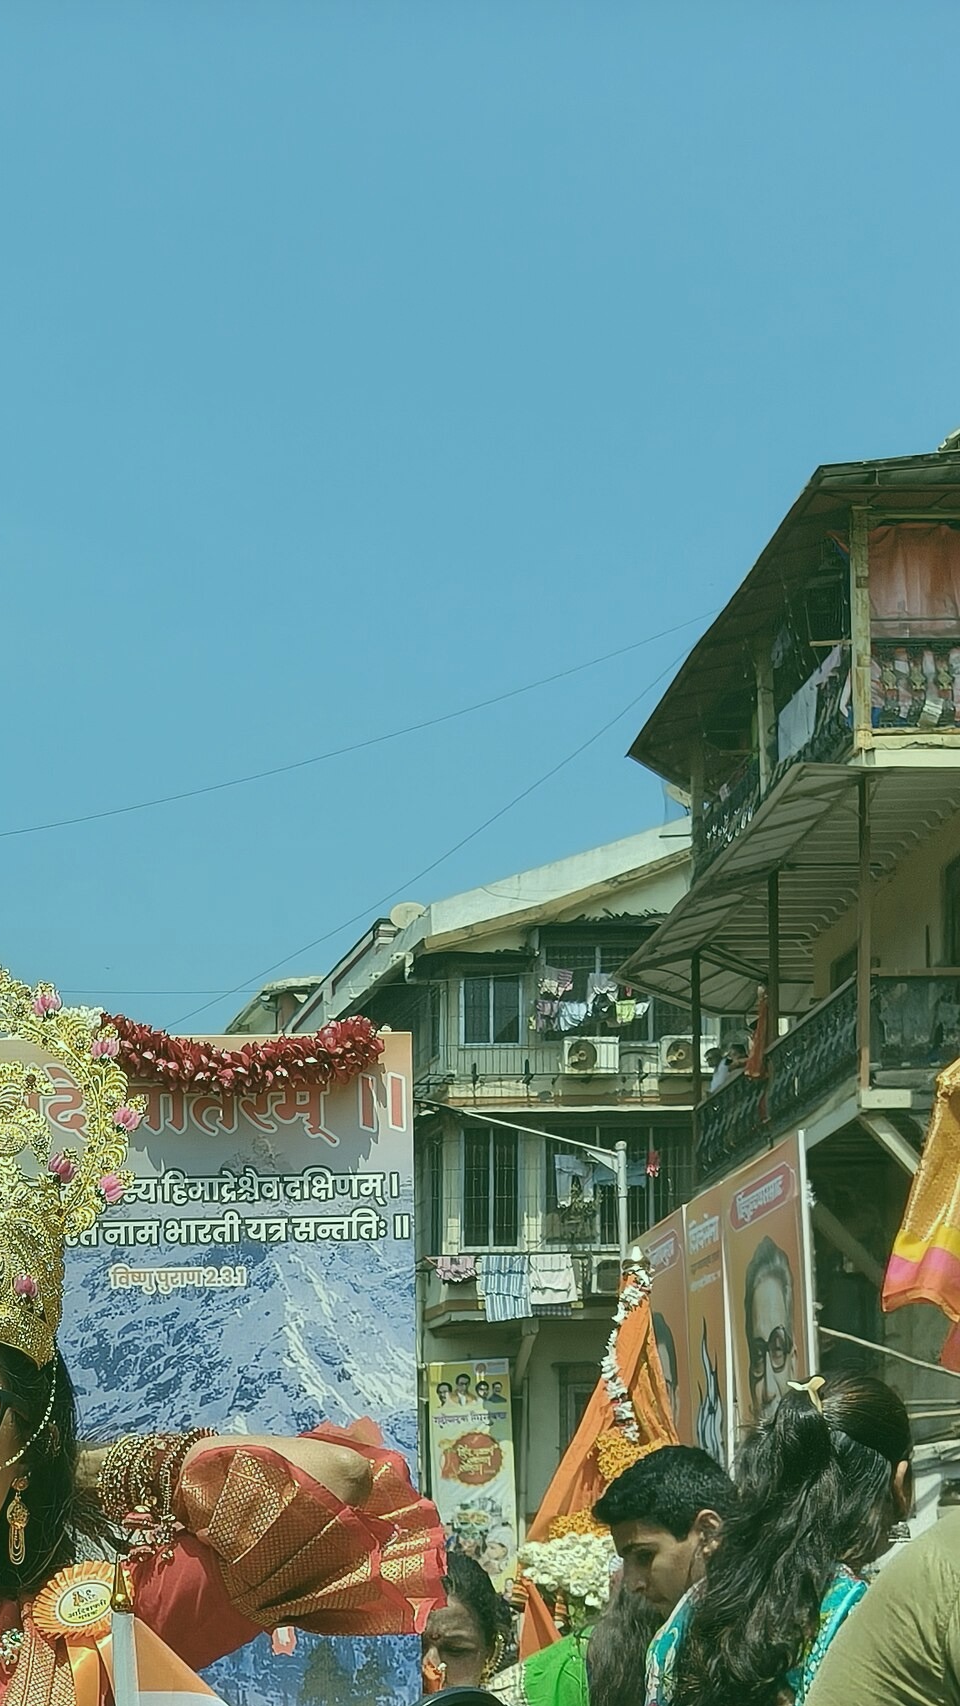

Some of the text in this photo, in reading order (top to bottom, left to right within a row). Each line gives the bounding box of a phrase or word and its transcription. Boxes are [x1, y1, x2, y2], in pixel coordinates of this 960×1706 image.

[283, 1166, 387, 1206] दक्षिणम्
[102, 1220, 160, 1246] नाम
[164, 1210, 241, 1245] भारती
[245, 1217, 289, 1243] यत्र
[291, 1207, 387, 1242] सन्ततिः
[111, 1264, 246, 1296] विष्णु पुराण 2.3.1
